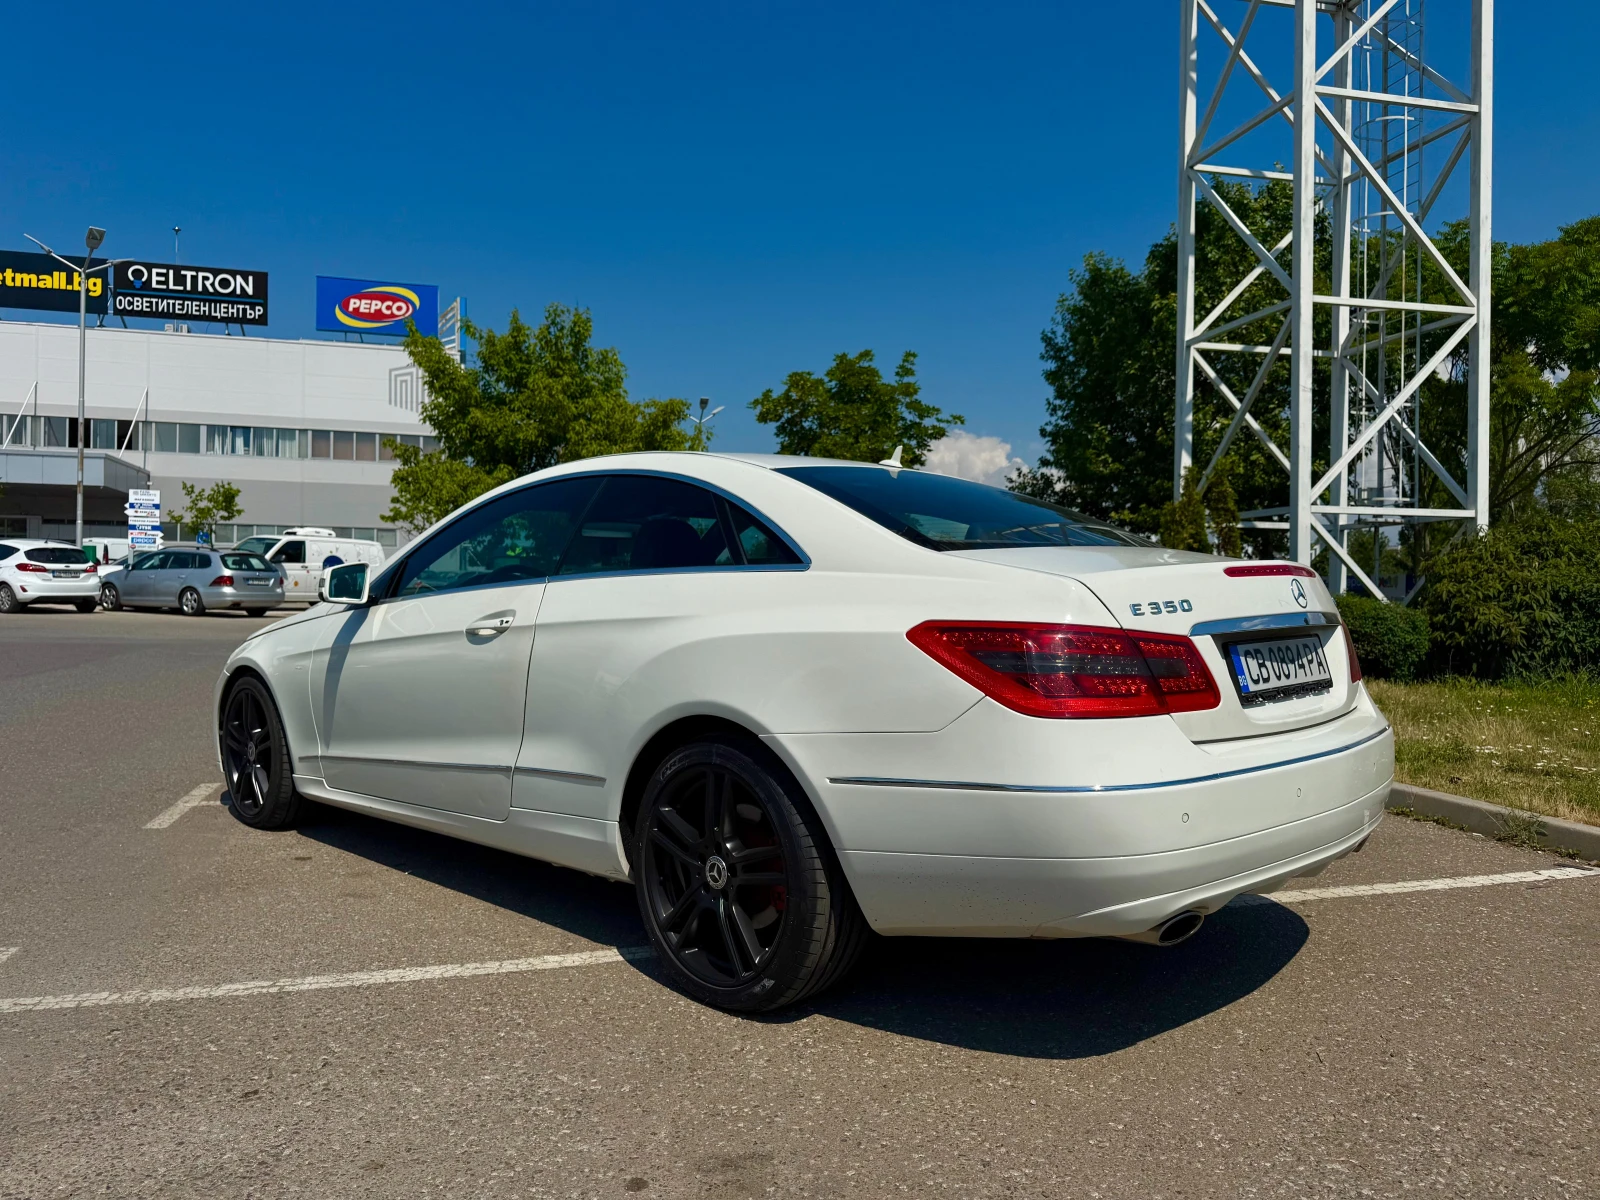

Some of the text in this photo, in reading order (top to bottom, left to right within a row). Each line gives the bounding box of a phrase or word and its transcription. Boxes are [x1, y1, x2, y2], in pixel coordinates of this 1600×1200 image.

[0, 268, 102, 297] tmall.bg
[116, 295, 263, 320] ОСВЕТИТЕЛЕН ЦЕНТЪР
[348, 298, 407, 316] PEPCO
